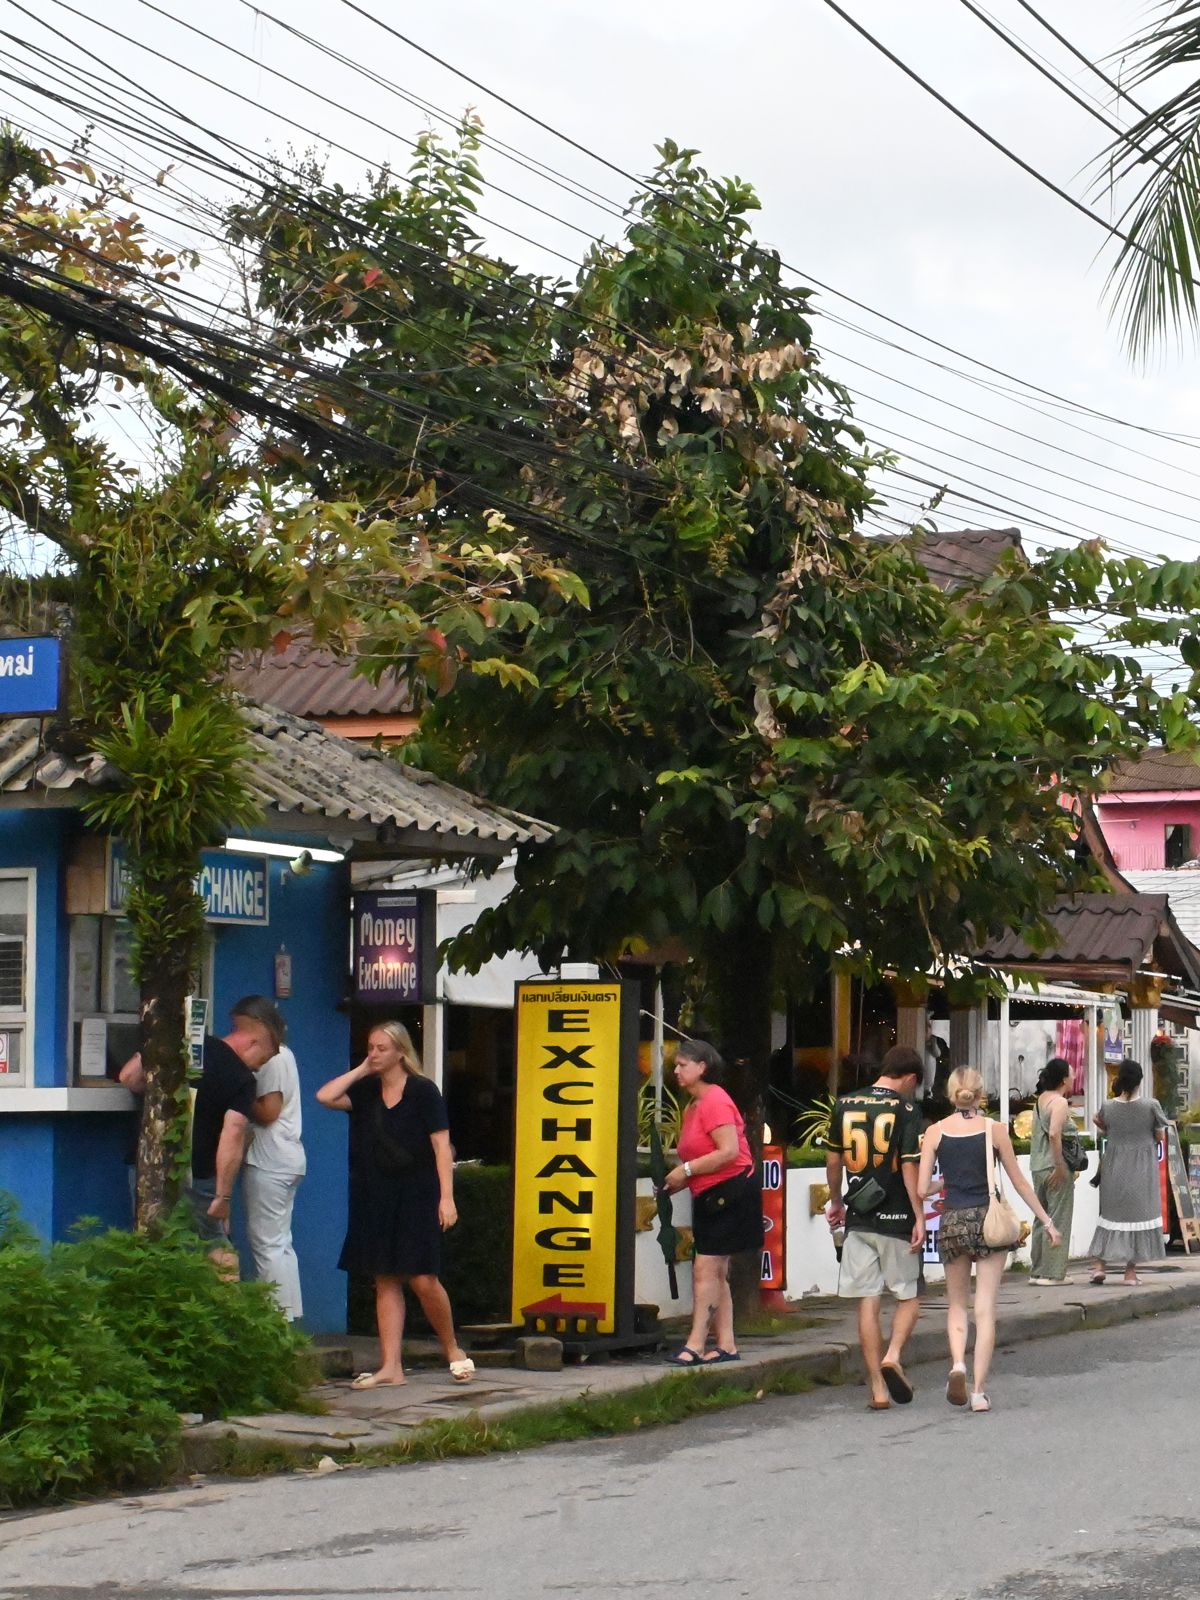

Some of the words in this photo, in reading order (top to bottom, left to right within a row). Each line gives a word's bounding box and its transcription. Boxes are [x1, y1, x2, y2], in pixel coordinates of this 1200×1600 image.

[361, 912, 416, 953] Money
[359, 956, 417, 997] Exchange
[522, 987, 618, 1003] แลกเปลี่ยนเงินตรา
[534, 1009, 597, 1288] EXCHANGE
[879, 1213, 908, 1221] DAIKIN
